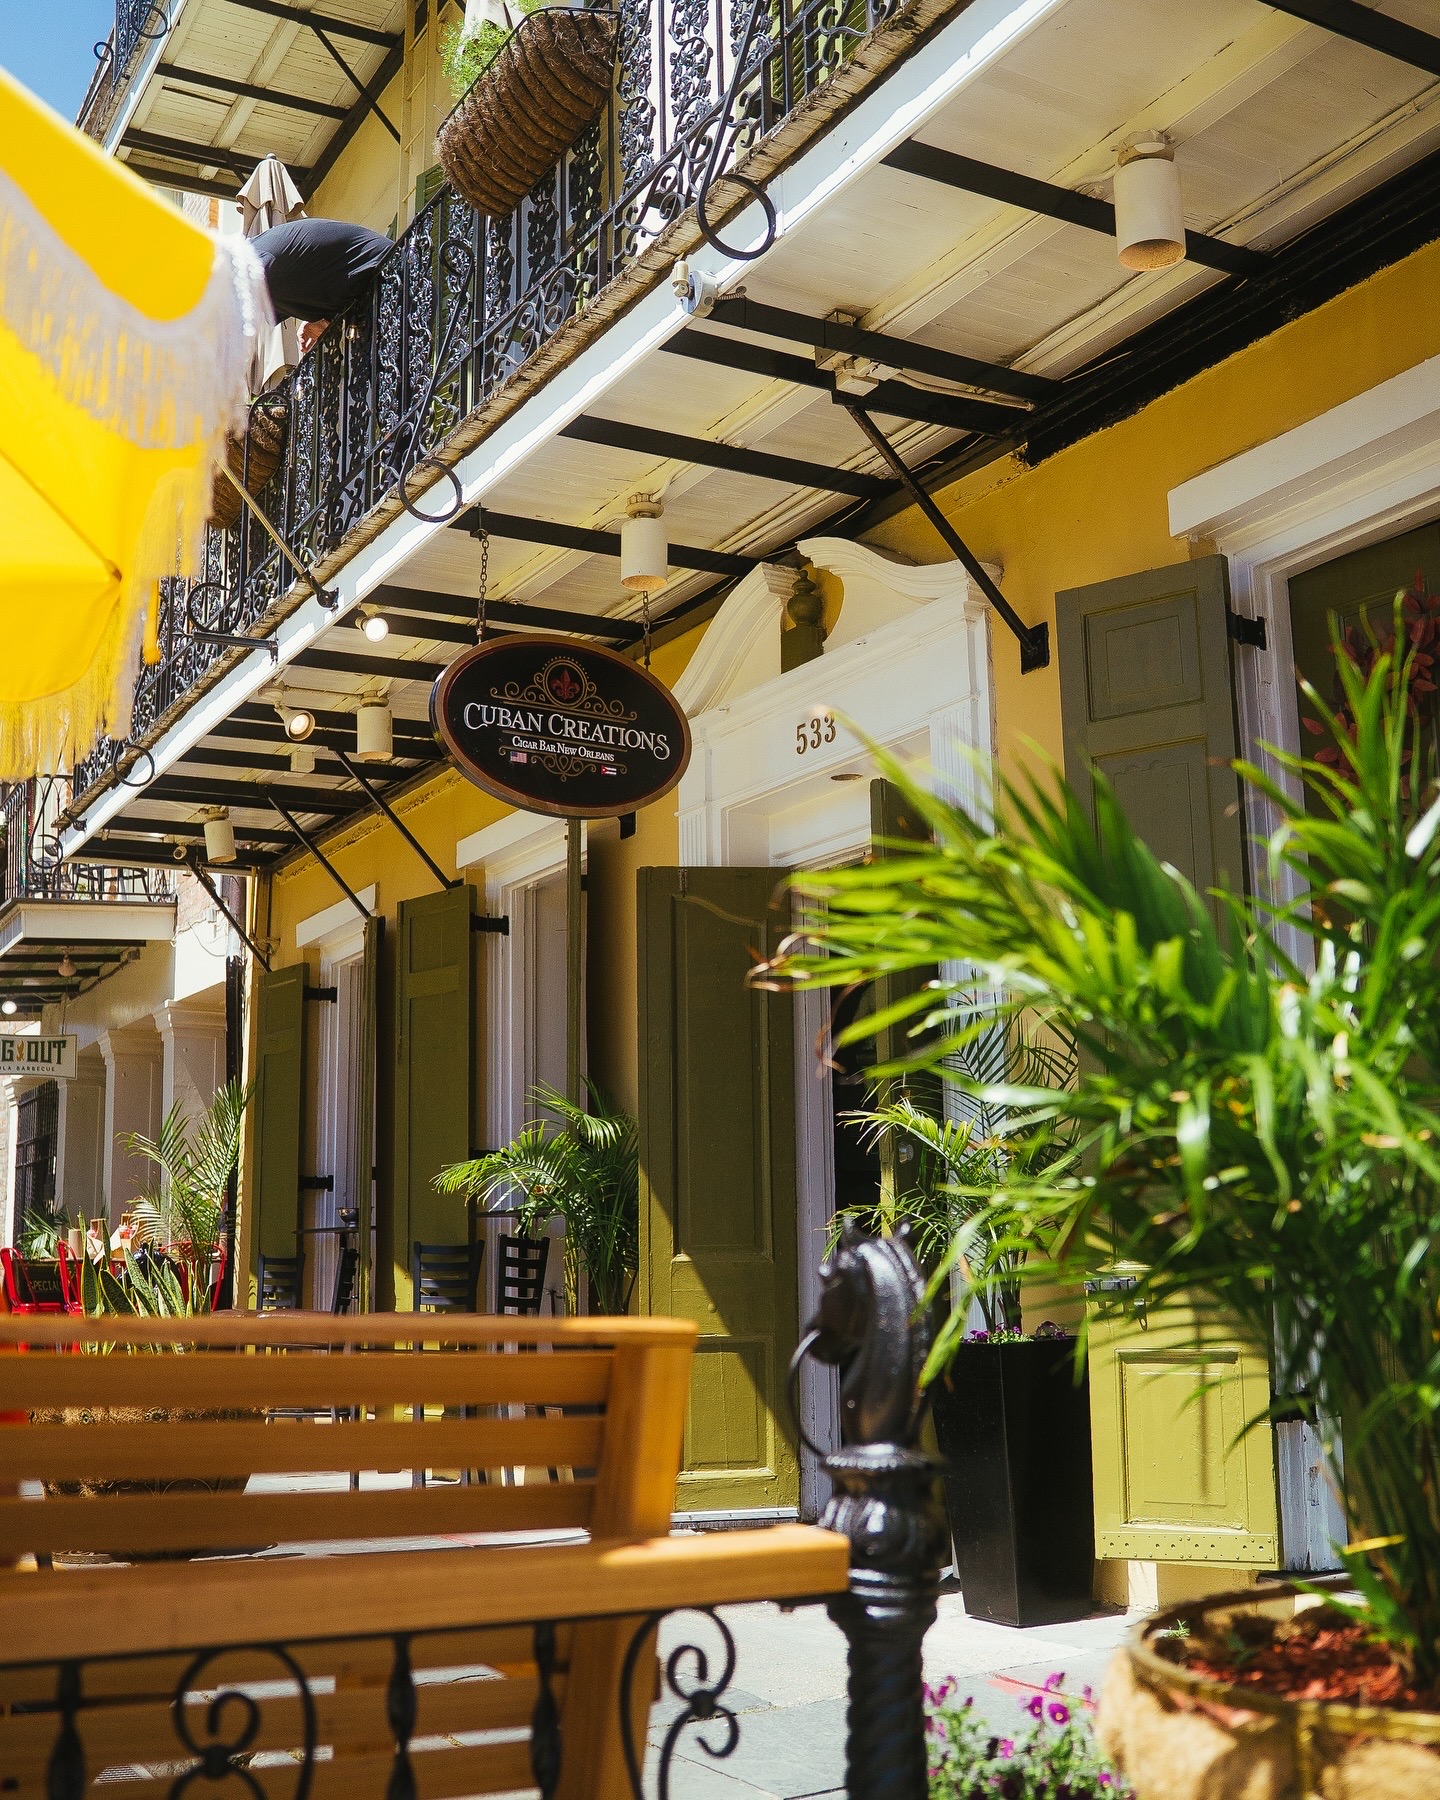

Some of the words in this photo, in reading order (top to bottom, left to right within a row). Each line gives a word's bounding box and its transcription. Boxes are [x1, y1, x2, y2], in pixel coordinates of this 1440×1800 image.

[463, 702, 544, 733] CUBAN
[547, 713, 671, 761] CREATIONS
[512, 735, 539, 751] CIGAR
[539, 739, 557, 753] BAR
[556, 742, 578, 757] NEW
[578, 746, 615, 762] ORLEANS
[796, 712, 836, 755] 533
[27, 1040, 67, 1065] OUT
